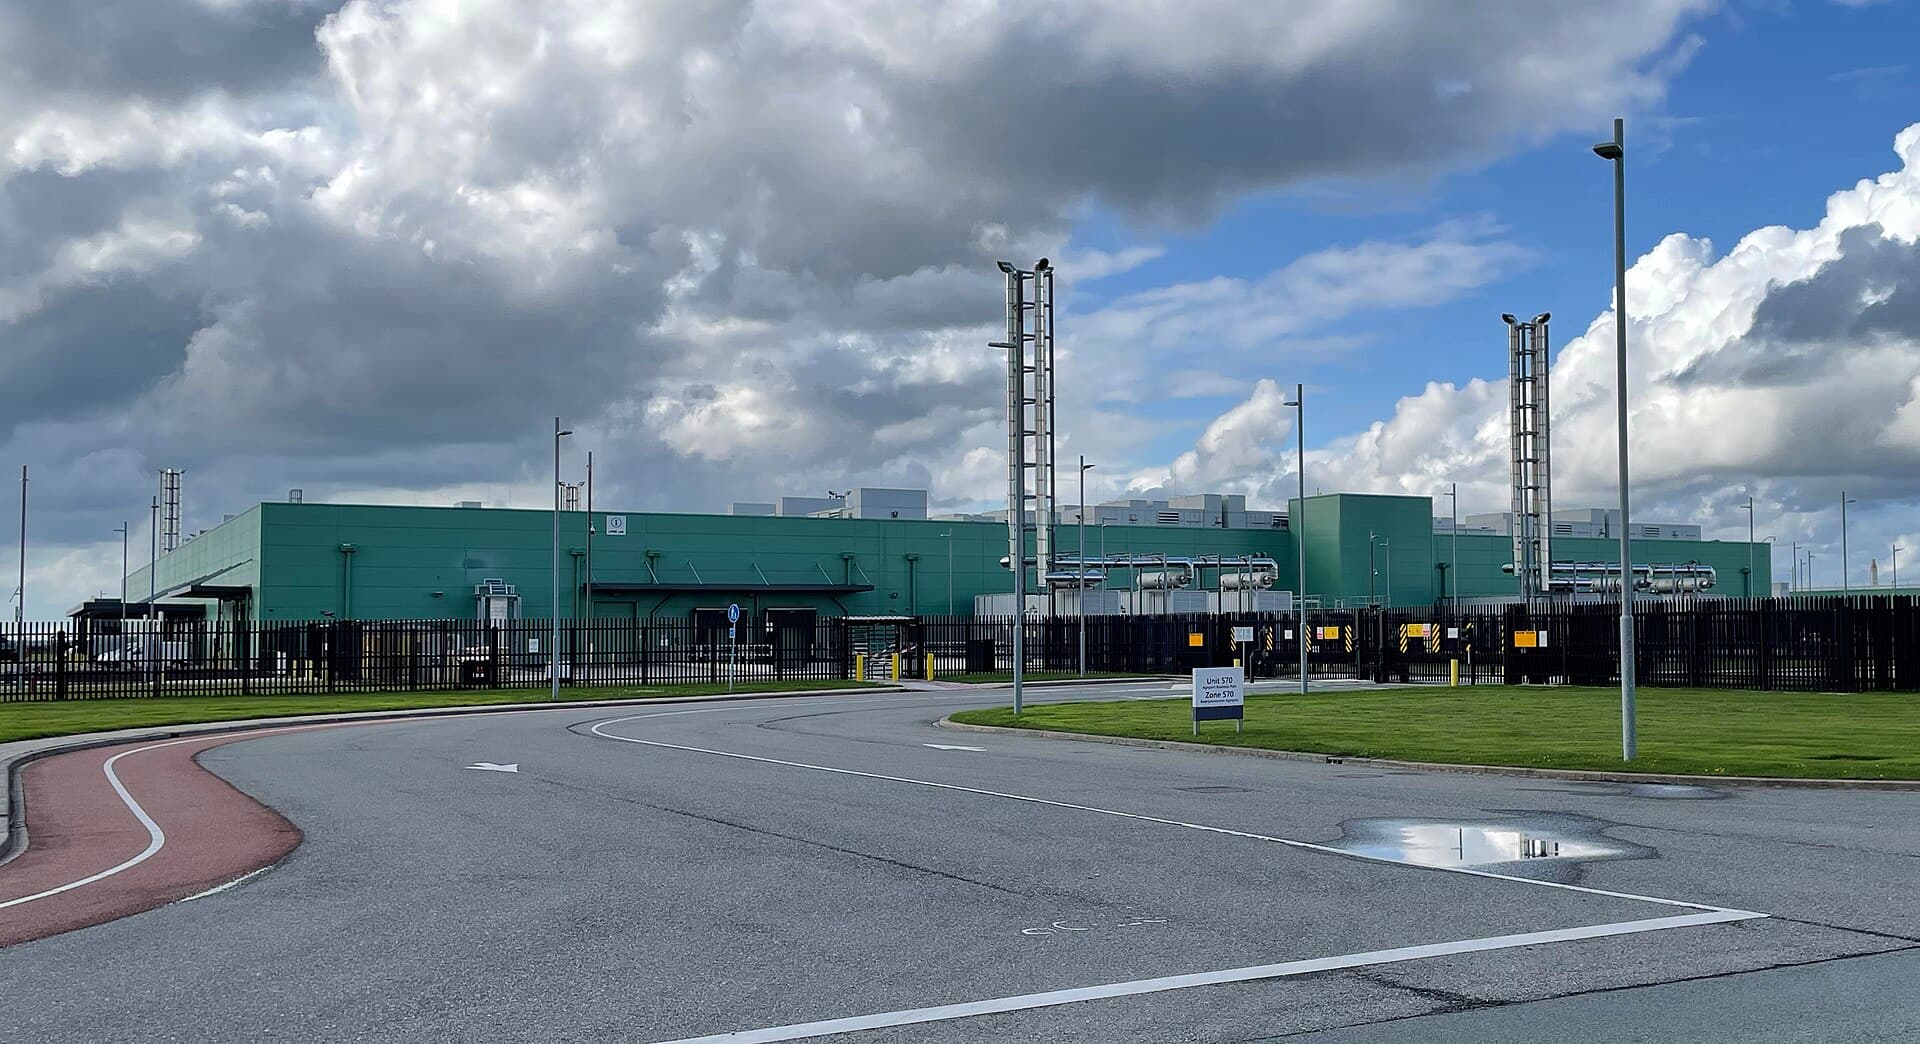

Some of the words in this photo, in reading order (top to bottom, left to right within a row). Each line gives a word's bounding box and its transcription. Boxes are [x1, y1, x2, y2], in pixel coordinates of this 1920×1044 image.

[1206, 677, 1220, 685] Unit
[1221, 676, 1233, 684] 570
[1205, 691, 1221, 699] Zone
[1222, 690, 1234, 698] 570
